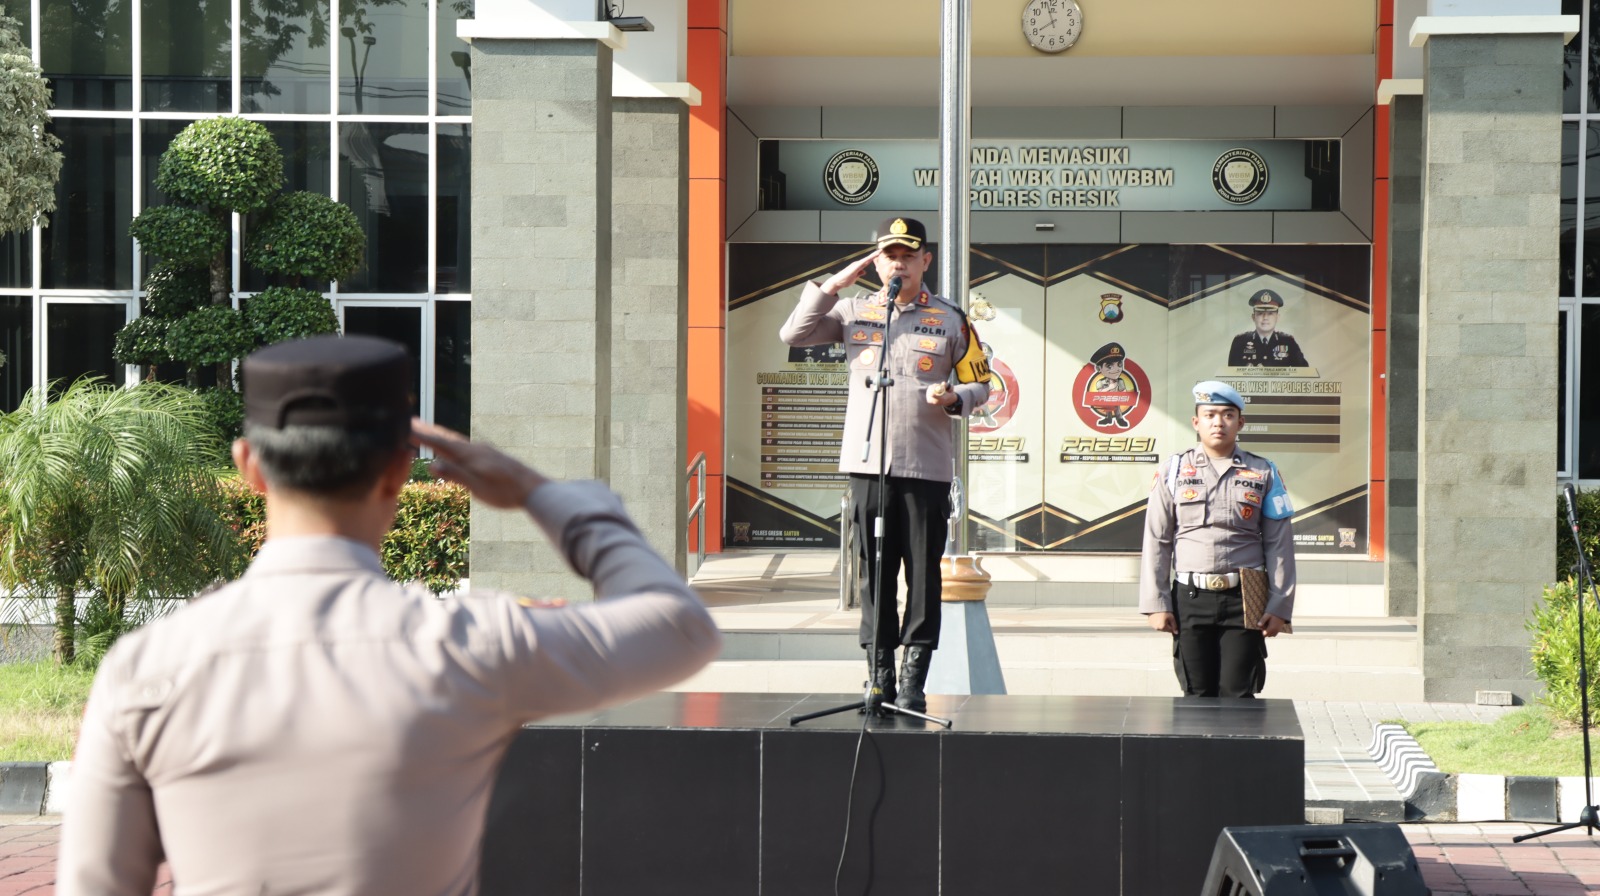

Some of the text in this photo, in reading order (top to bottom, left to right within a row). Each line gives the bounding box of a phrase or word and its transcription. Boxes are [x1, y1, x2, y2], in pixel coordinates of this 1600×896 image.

[1030, 18, 1036, 26] 9
[1049, 38, 1055, 46] 6
[970, 148, 1129, 166] NDA MEMASUKI
[1008, 169, 1054, 187] WBK
[1061, 169, 1101, 187] DAN
[1108, 169, 1173, 187] WBBM
[970, 189, 1119, 207] POLRES GRESIK
[914, 326, 946, 336] POLRI
[756, 372, 849, 386] COMMANDER WISH KAP
[1249, 381, 1268, 393] WISH
[1271, 381, 1311, 393] KAPOLRES
[1313, 382, 1342, 393] GRESIK
[969, 437, 1025, 451] ESISI
[1062, 436, 1157, 452] PRESISI
[1178, 478, 1204, 487] DANIEL
[1235, 480, 1263, 491] POLRI
